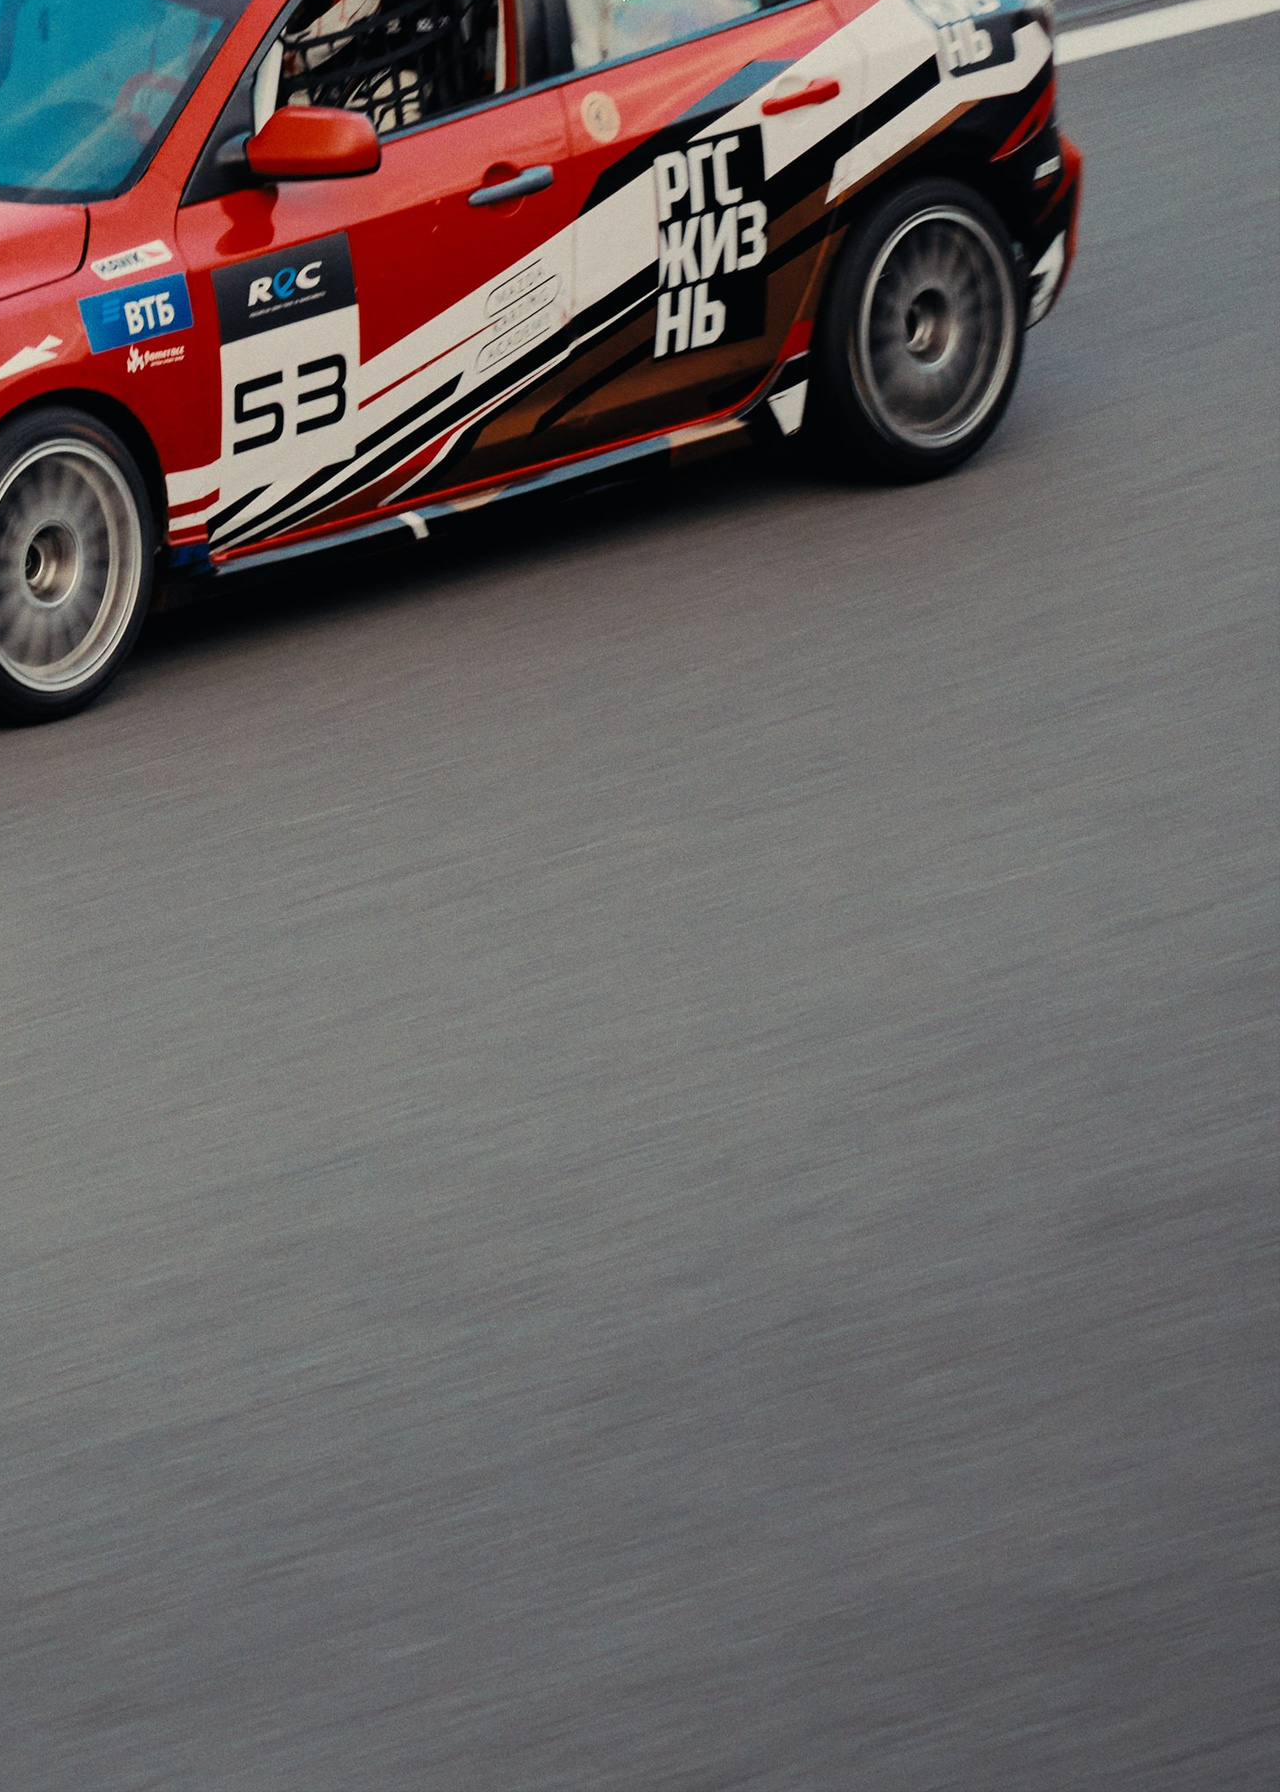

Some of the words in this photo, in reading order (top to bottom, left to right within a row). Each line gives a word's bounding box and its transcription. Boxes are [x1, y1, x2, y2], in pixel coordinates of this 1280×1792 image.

[653, 135, 744, 224] РГС
[658, 201, 768, 289] ЖИЗ
[124, 291, 175, 335] ВТБ
[653, 286, 726, 359] НЬ
[233, 353, 347, 455] 53
